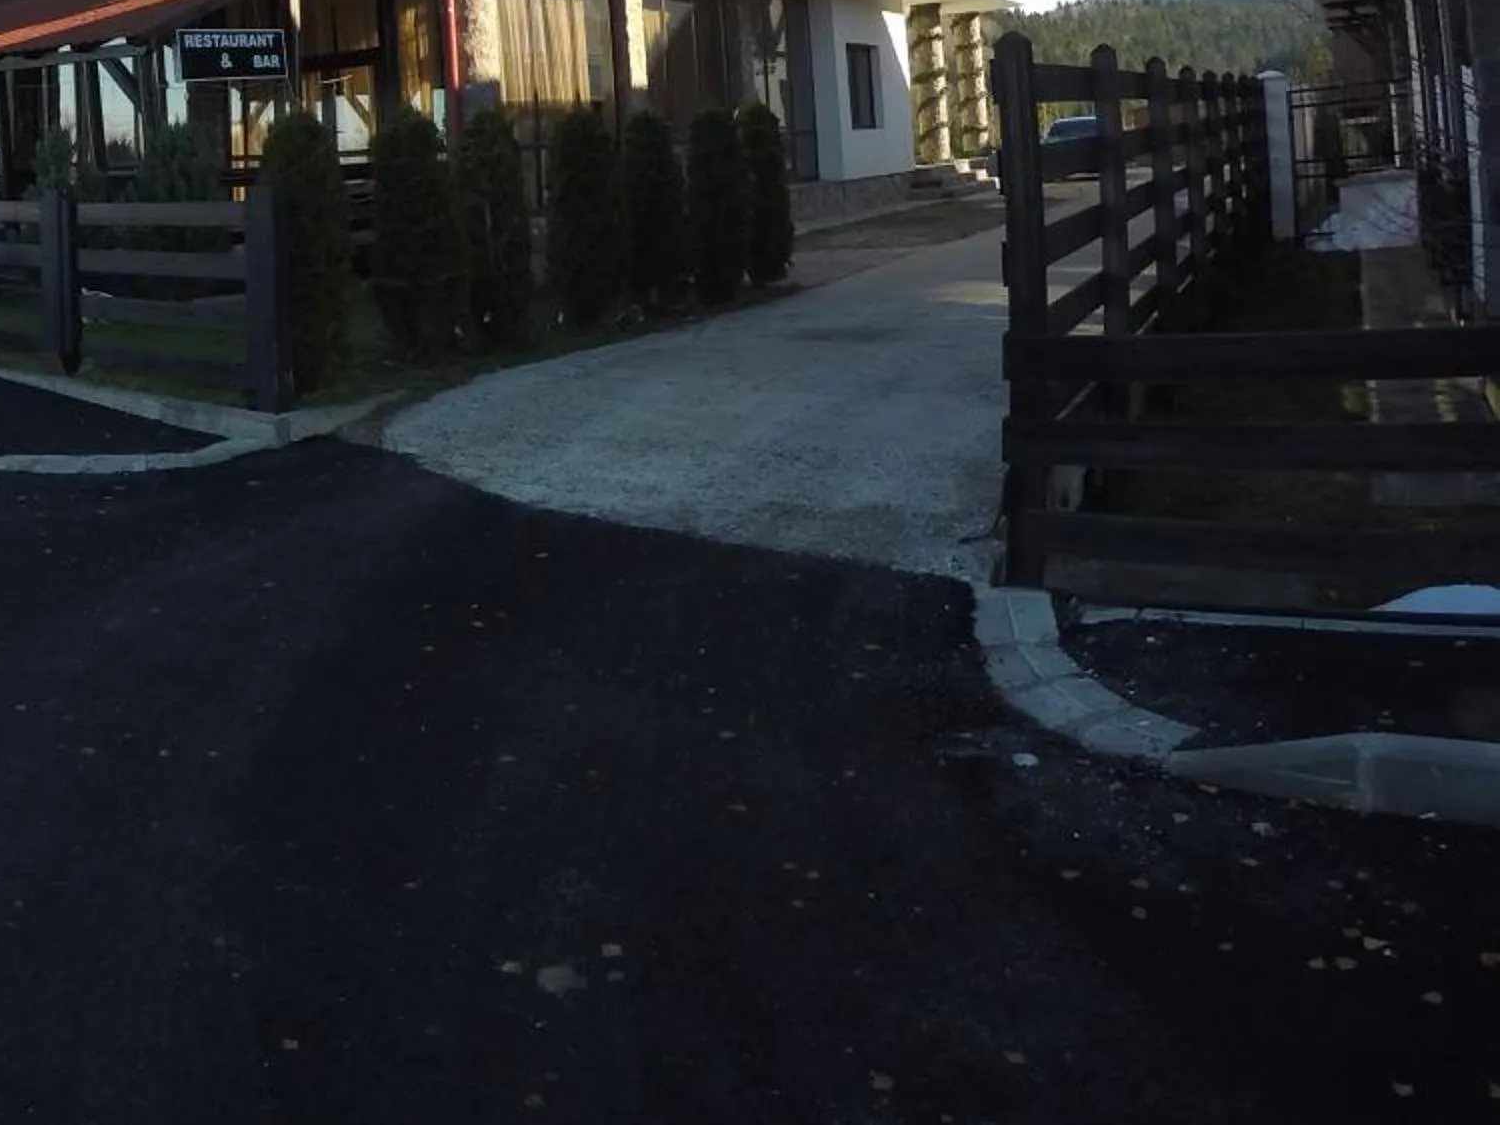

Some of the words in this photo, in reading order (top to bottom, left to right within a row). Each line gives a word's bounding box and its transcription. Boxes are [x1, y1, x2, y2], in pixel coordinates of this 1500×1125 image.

[183, 34, 274, 48] RESTAURANT
[220, 52, 233, 68] &
[253, 54, 280, 68] BAR
